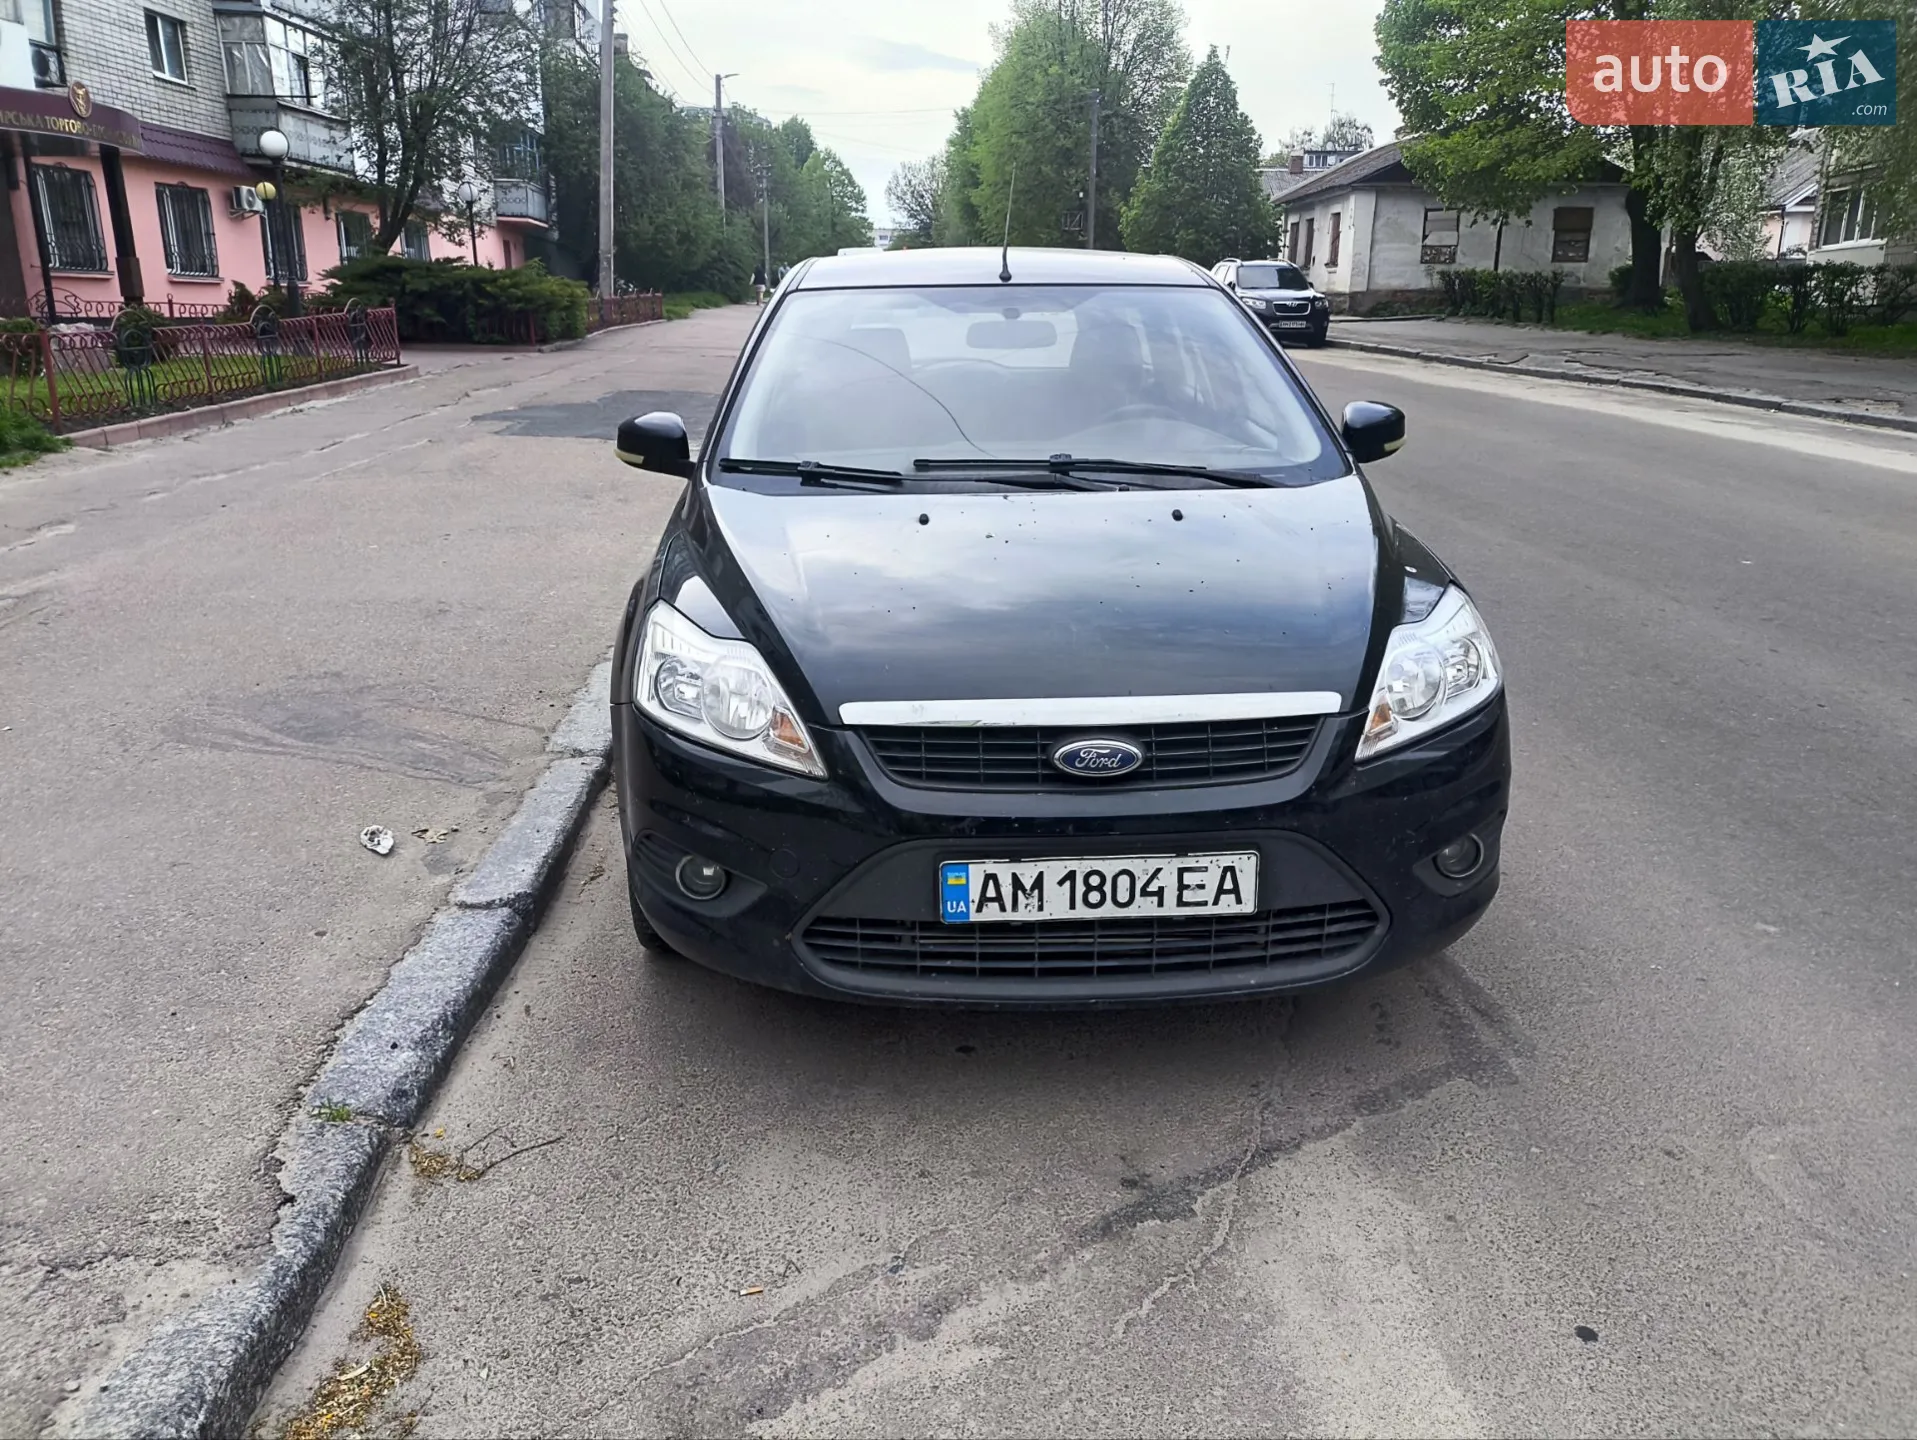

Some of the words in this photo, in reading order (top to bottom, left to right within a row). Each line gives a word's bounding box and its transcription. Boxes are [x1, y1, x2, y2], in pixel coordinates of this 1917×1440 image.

[1075, 748, 1122, 768] Ford
[975, 870, 1044, 914] AM
[1057, 867, 1164, 911] 1804
[1176, 865, 1243, 908] EA
[947, 900, 967, 913] UA
